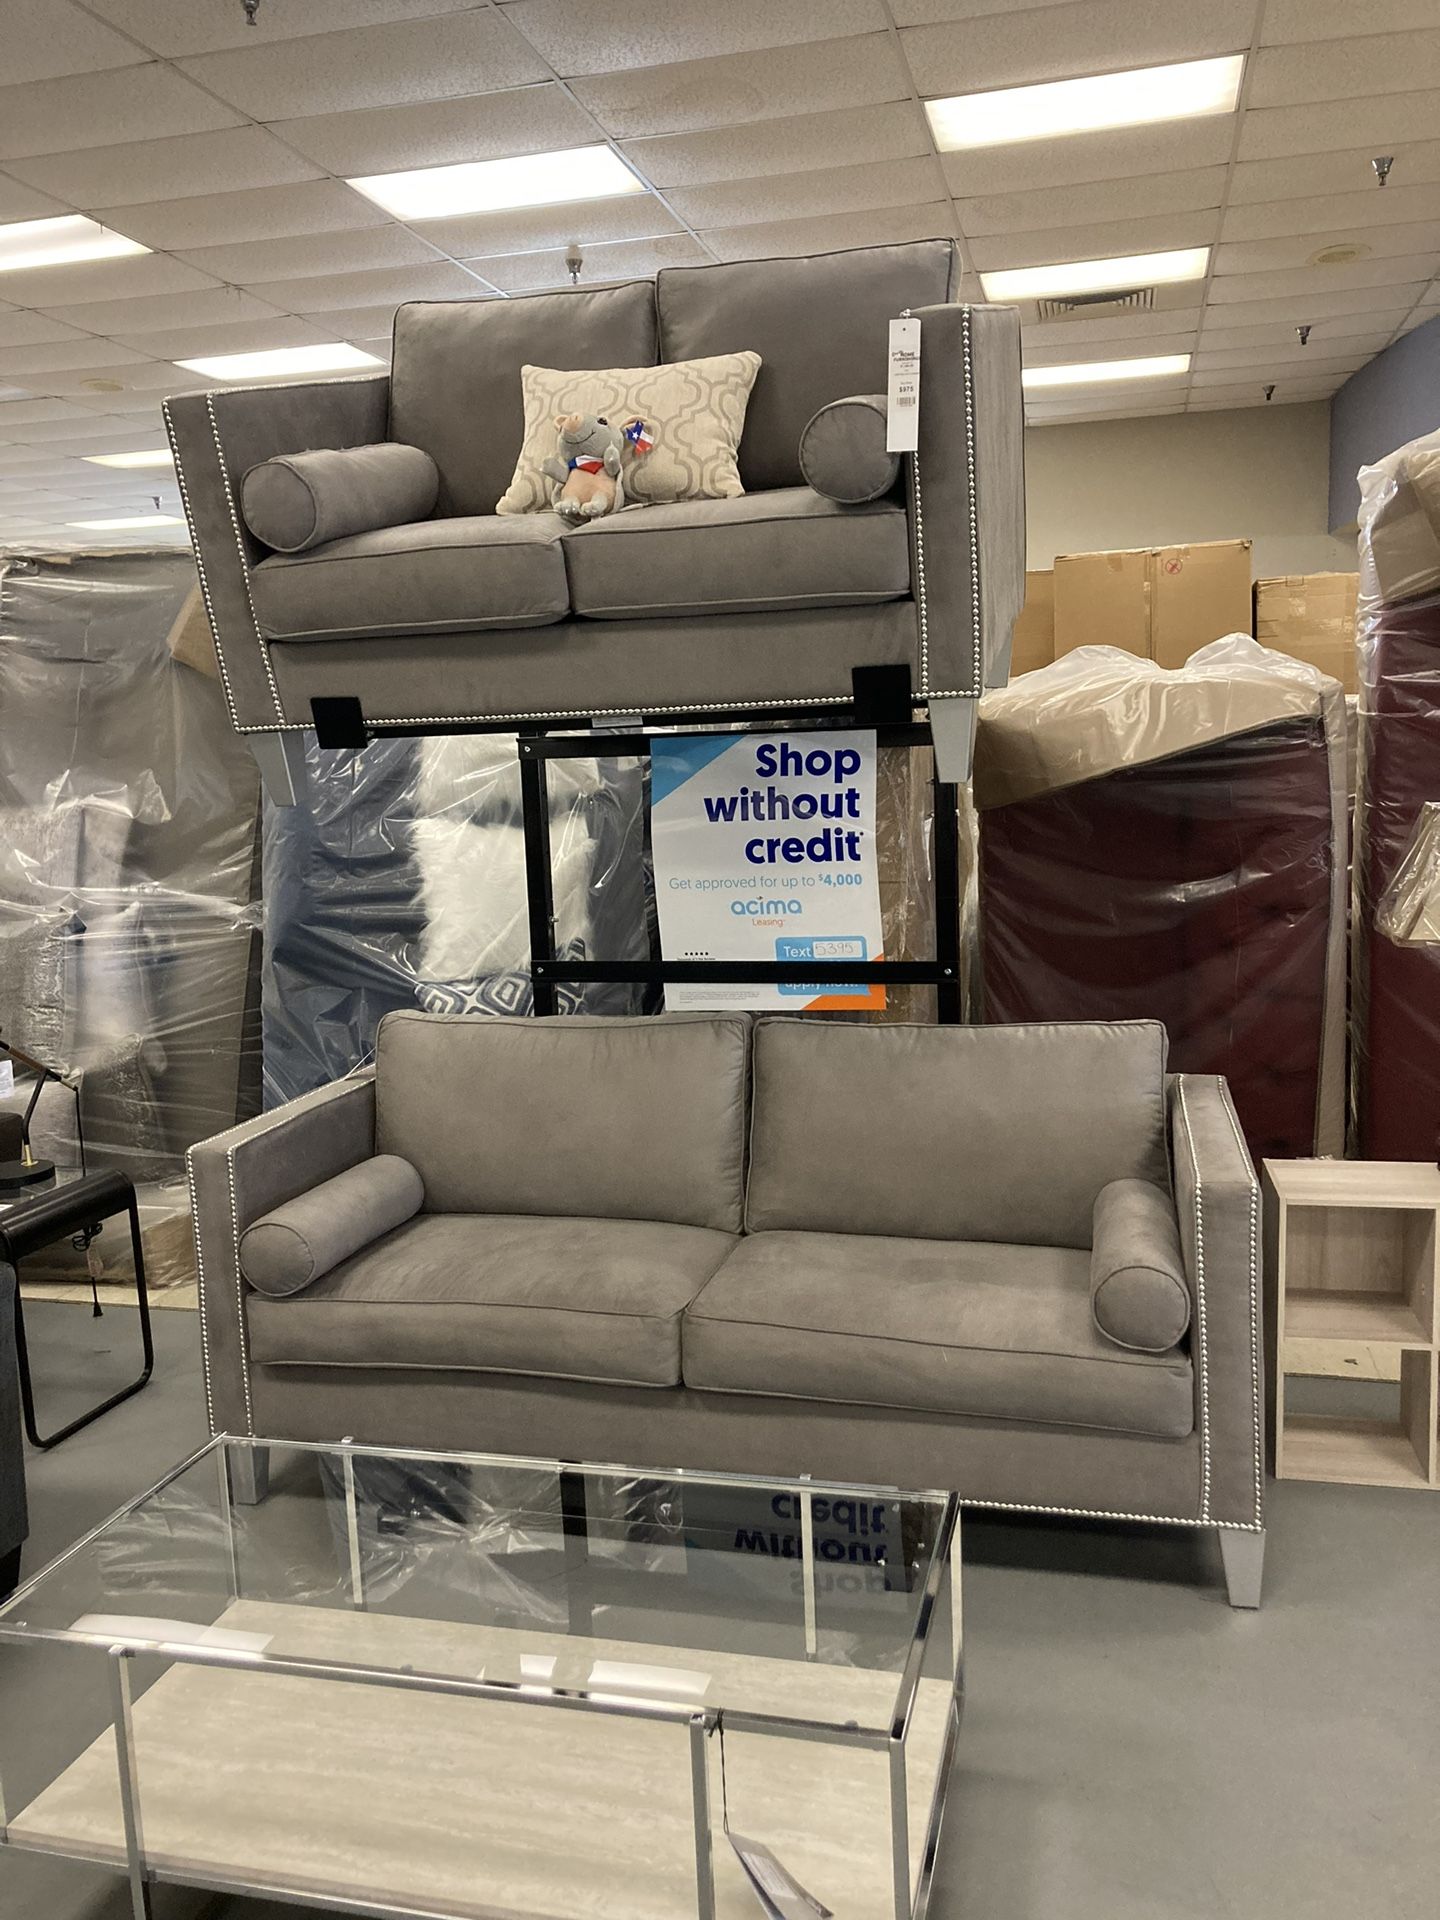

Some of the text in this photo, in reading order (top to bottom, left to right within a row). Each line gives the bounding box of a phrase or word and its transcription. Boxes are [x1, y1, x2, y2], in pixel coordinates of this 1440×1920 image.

[756, 742, 861, 783] Shop
[704, 786, 860, 822] without
[669, 873, 862, 891] Get approved for up to $4,000
[731, 896, 802, 915] acima
[783, 946, 812, 957] Text
[815, 943, 854, 956] 5395
